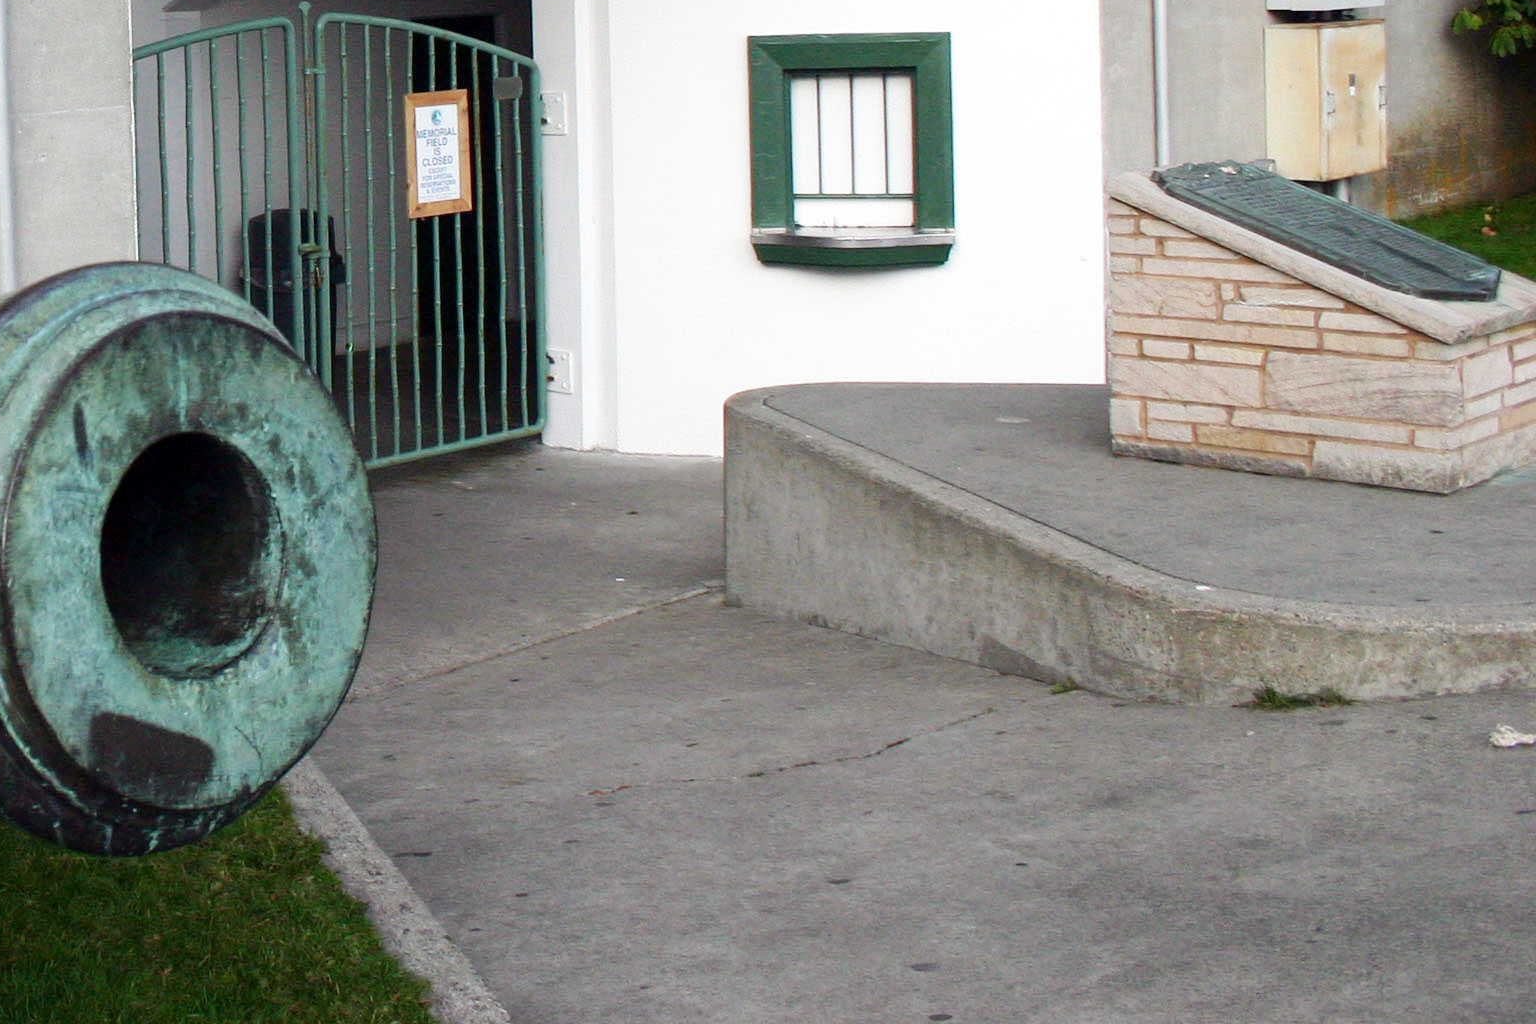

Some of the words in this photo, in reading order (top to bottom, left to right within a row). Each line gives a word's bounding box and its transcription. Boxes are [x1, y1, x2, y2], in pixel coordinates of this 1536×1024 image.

[417, 127, 456, 138] MEMORIAL
[426, 137, 448, 148] FIELD
[433, 147, 441, 156] IS
[423, 155, 453, 166] CLOSED
